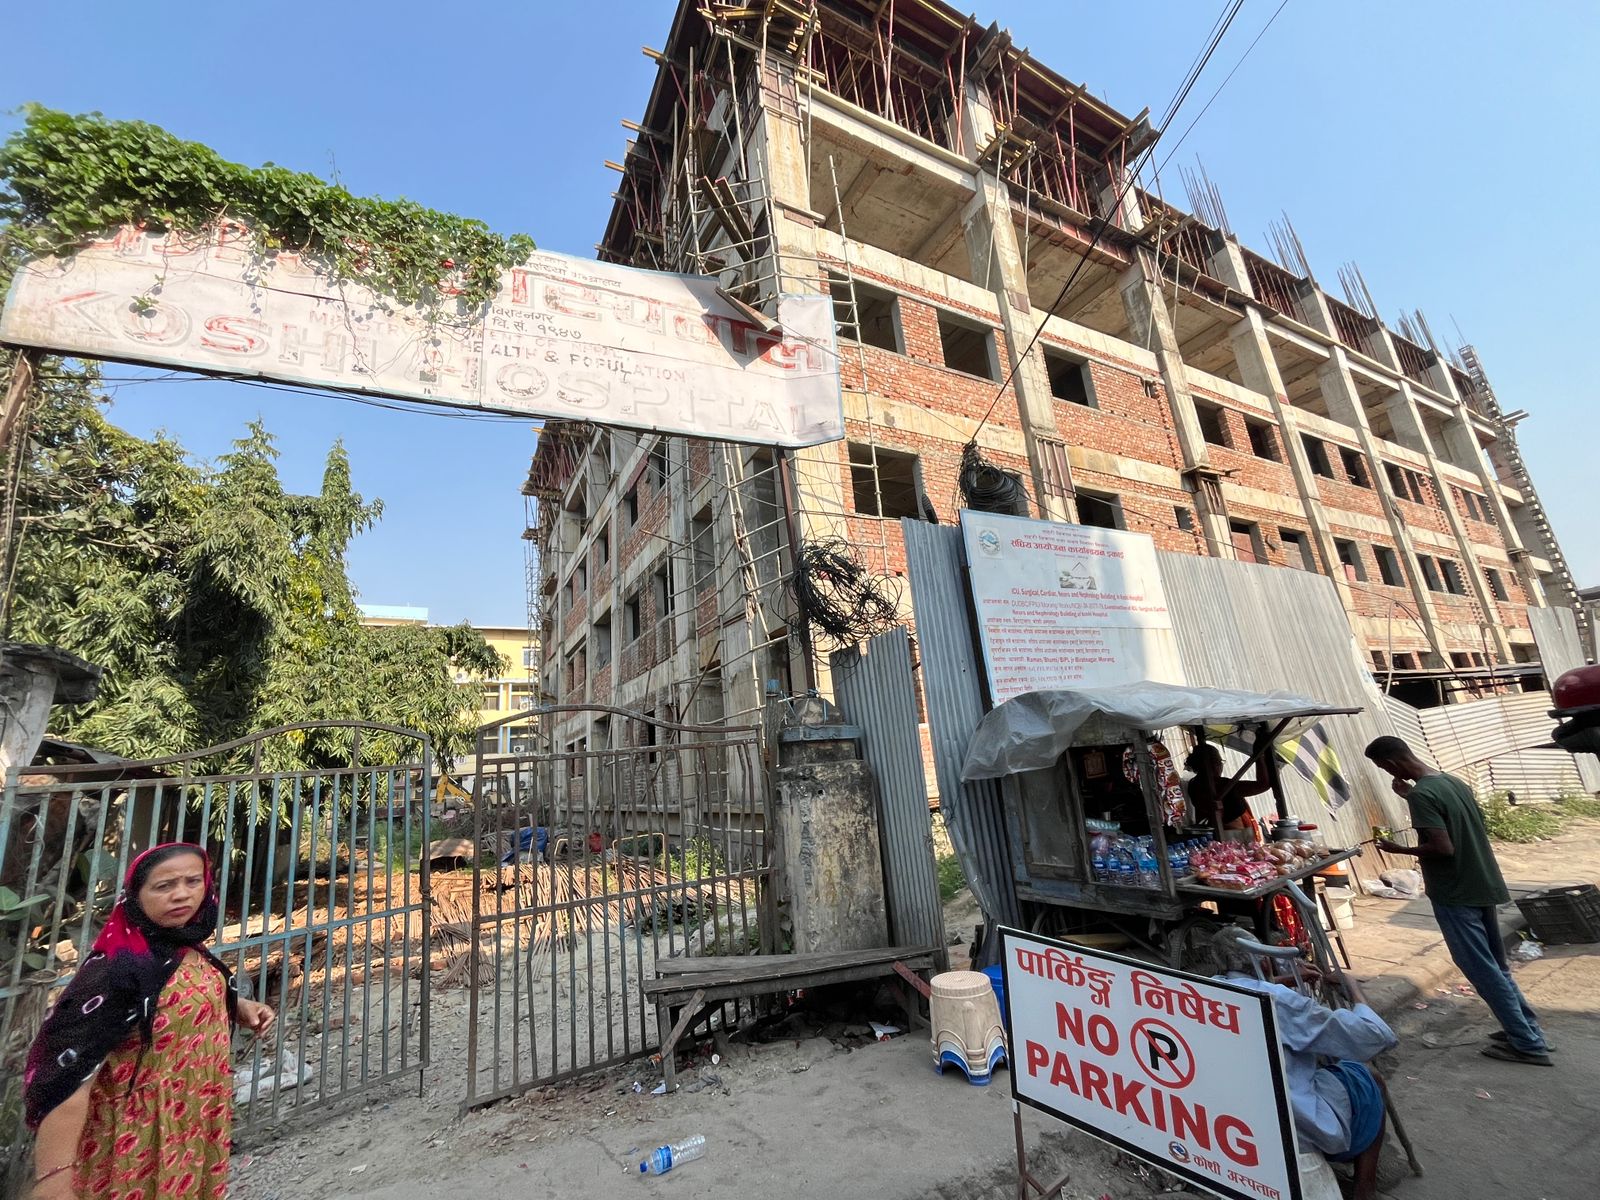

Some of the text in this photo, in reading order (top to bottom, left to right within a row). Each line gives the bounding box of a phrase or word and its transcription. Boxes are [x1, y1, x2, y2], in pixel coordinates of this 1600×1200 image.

[543, 350, 559, 364] &
[1055, 1001, 1120, 1057] NO
[1130, 970, 1241, 1035] निषेध
[1026, 1039, 1260, 1167] PARKING
[1192, 1153, 1281, 1200] कोशी अस्पताल
